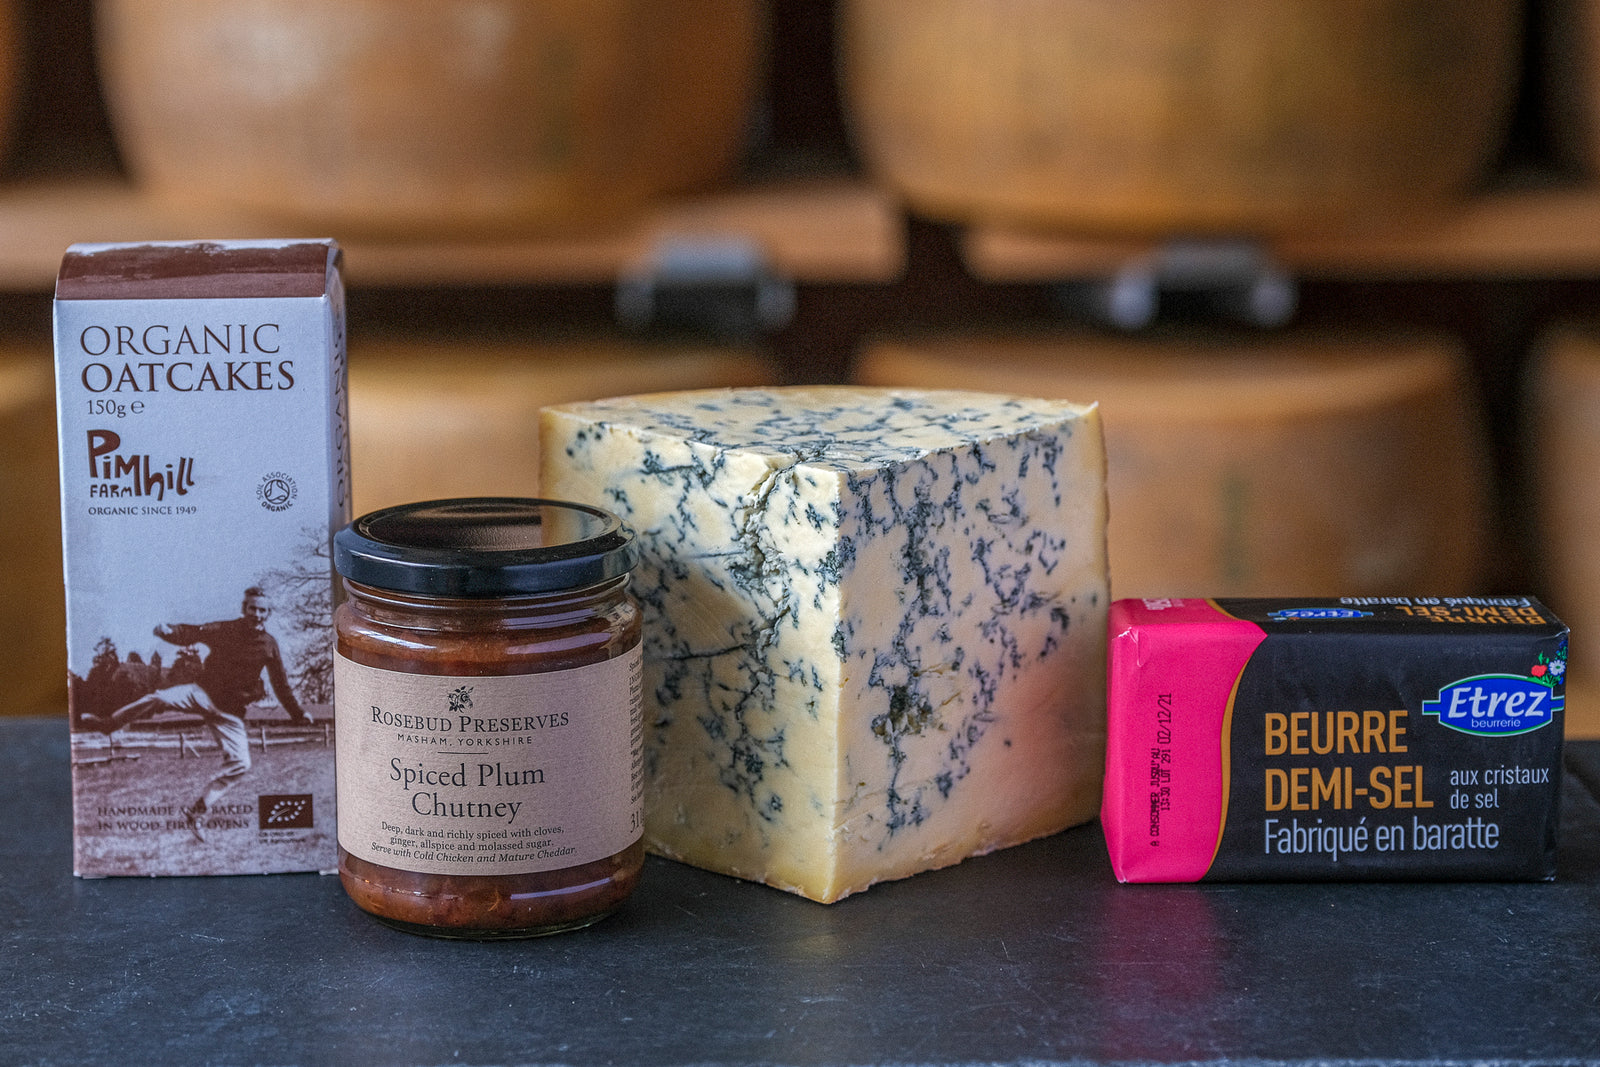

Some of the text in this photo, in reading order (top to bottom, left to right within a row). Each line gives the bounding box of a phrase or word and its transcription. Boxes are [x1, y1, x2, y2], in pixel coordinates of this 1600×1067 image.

[80, 323, 281, 356] ORGANIC
[81, 360, 295, 393] OATCAKES
[87, 400, 127, 418] 150g
[90, 484, 133, 498] FARM
[256, 471, 298, 501] SOIL ASSOCIATION
[88, 505, 197, 516] ORGANIC SINCE 1949
[261, 500, 293, 513] ORGANIC
[1395, 605, 1539, 617] DEMI-SEL
[1427, 614, 1548, 626] BEURRE
[1448, 687, 1547, 718] Etrez
[371, 706, 569, 732] ROSEBUD PRESERVES
[1471, 718, 1521, 728] beurrerie
[397, 733, 533, 746] MASHAM, YORKSHIRE
[1264, 710, 1409, 755] BEURRE
[1157, 692, 1171, 811] 13:30 LOT 291 02/12/21
[390, 757, 545, 790] Spiced Plum
[1450, 764, 1550, 786] aux cristaux
[1265, 765, 1434, 811] DEMI-SEL
[1450, 787, 1500, 809] de sel
[97, 806, 174, 817] HANDMADE
[211, 804, 253, 815] BAKED
[412, 791, 523, 824] Chutney
[98, 821, 113, 831] IN
[207, 818, 250, 830] OVENS
[381, 822, 565, 841] Deep, dark and richly spiced with cloves,
[390, 836, 555, 852] ginger, allspice and molassed sugar.
[1264, 816, 1499, 861] Fabriqué en baratte
[371, 842, 577, 864] Serve with Cold Chicken and Mature Cheddar.
